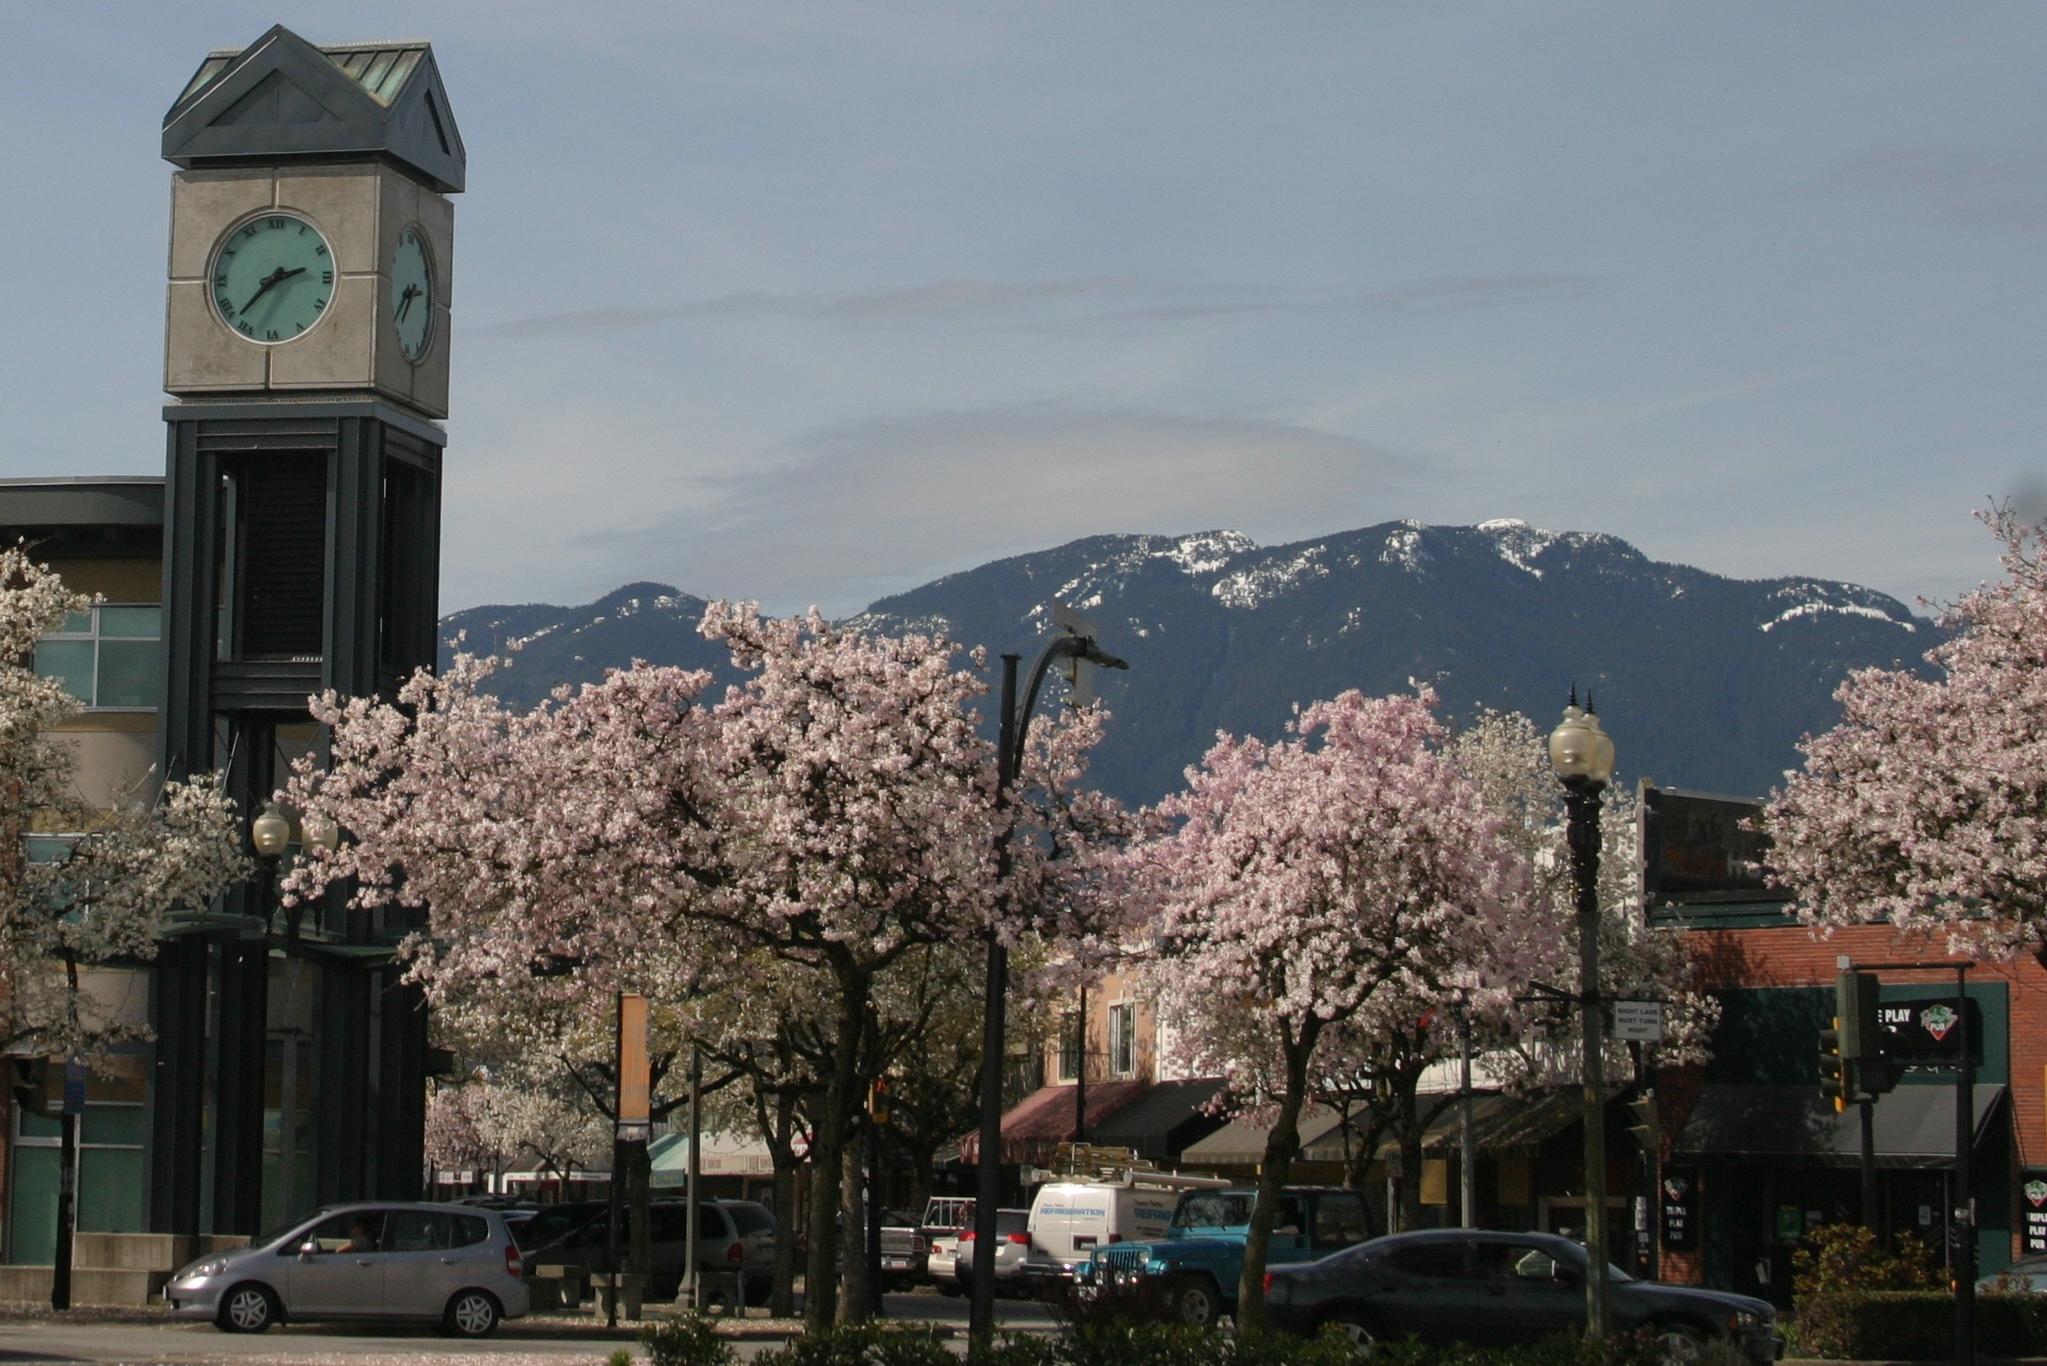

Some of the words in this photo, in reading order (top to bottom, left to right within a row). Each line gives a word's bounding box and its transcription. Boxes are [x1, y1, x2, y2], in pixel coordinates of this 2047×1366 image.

[268, 219, 285, 229] XII
[243, 225, 257, 239] XI
[299, 226, 306, 235] I
[224, 247, 236, 257] X
[315, 244, 326, 256] II
[217, 274, 227, 288] IX
[322, 271, 332, 284] III
[314, 298, 326, 313] IV
[238, 320, 254, 335] VII
[296, 322, 305, 333] V
[266, 329, 279, 340] VI
[1884, 1009, 1911, 1023] PLAY
[2029, 1225, 2047, 1236] PLAY
[2030, 1238, 2046, 1249] PUB
